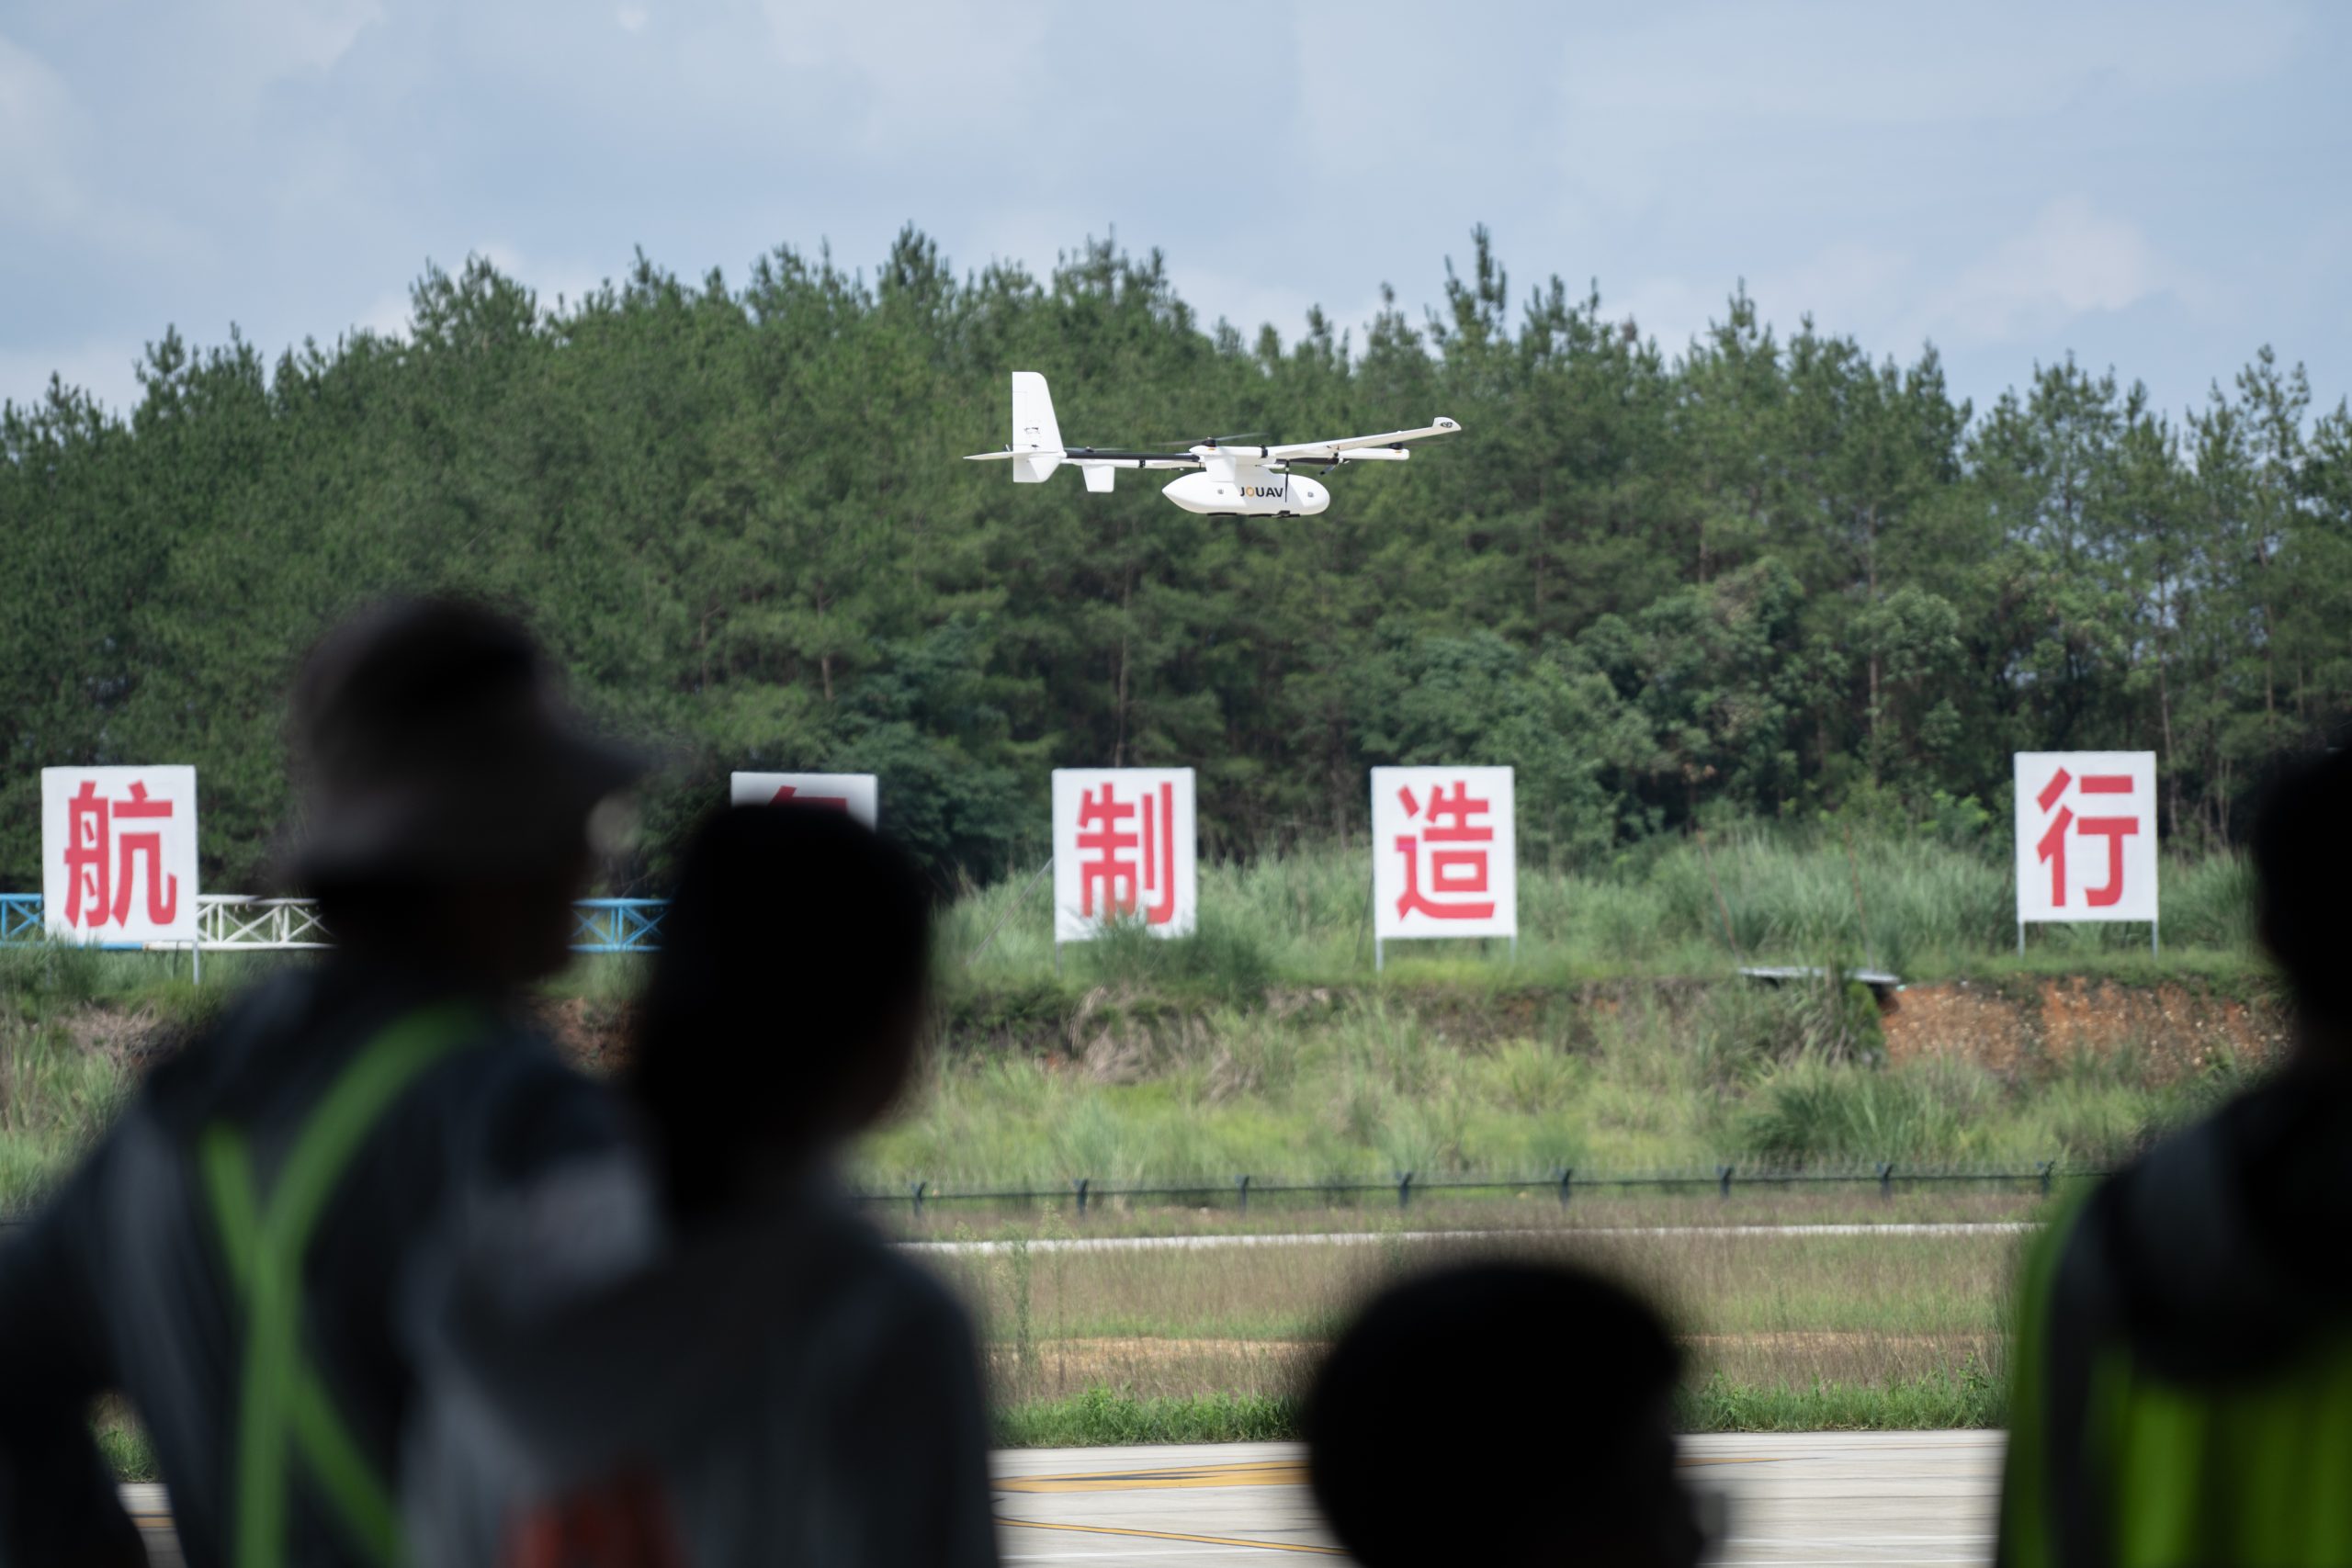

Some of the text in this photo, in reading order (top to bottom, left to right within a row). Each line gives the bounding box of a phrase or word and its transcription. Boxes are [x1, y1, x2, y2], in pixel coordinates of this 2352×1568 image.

[1240, 486, 1283, 498] JOUAV
[64, 780, 177, 930] 航
[1077, 782, 1174, 924] 制
[1396, 780, 1496, 921] 造
[2036, 766, 2139, 908] 行
